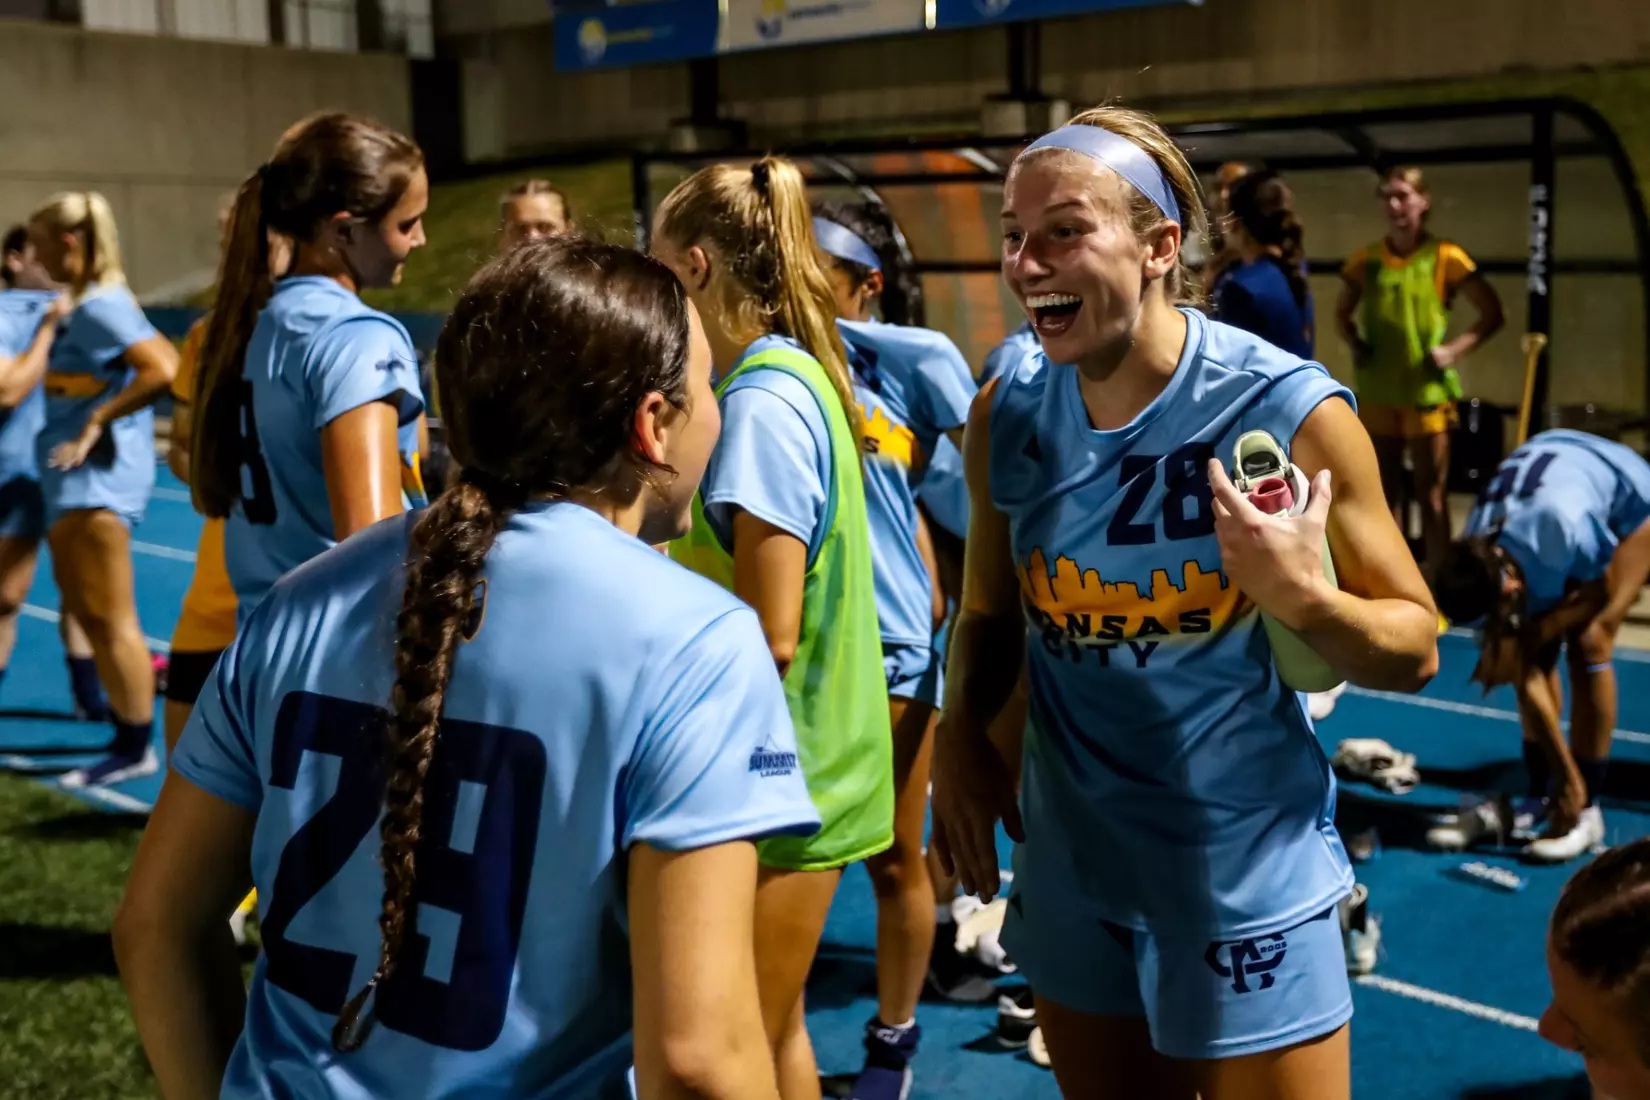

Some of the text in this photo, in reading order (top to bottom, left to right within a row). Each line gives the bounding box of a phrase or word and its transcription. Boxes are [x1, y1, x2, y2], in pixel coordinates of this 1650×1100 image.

[1106, 441, 1216, 546] 28
[1042, 632, 1159, 668] CITY
[260, 690, 547, 1052] 29
[1260, 941, 1288, 954] ROOS
